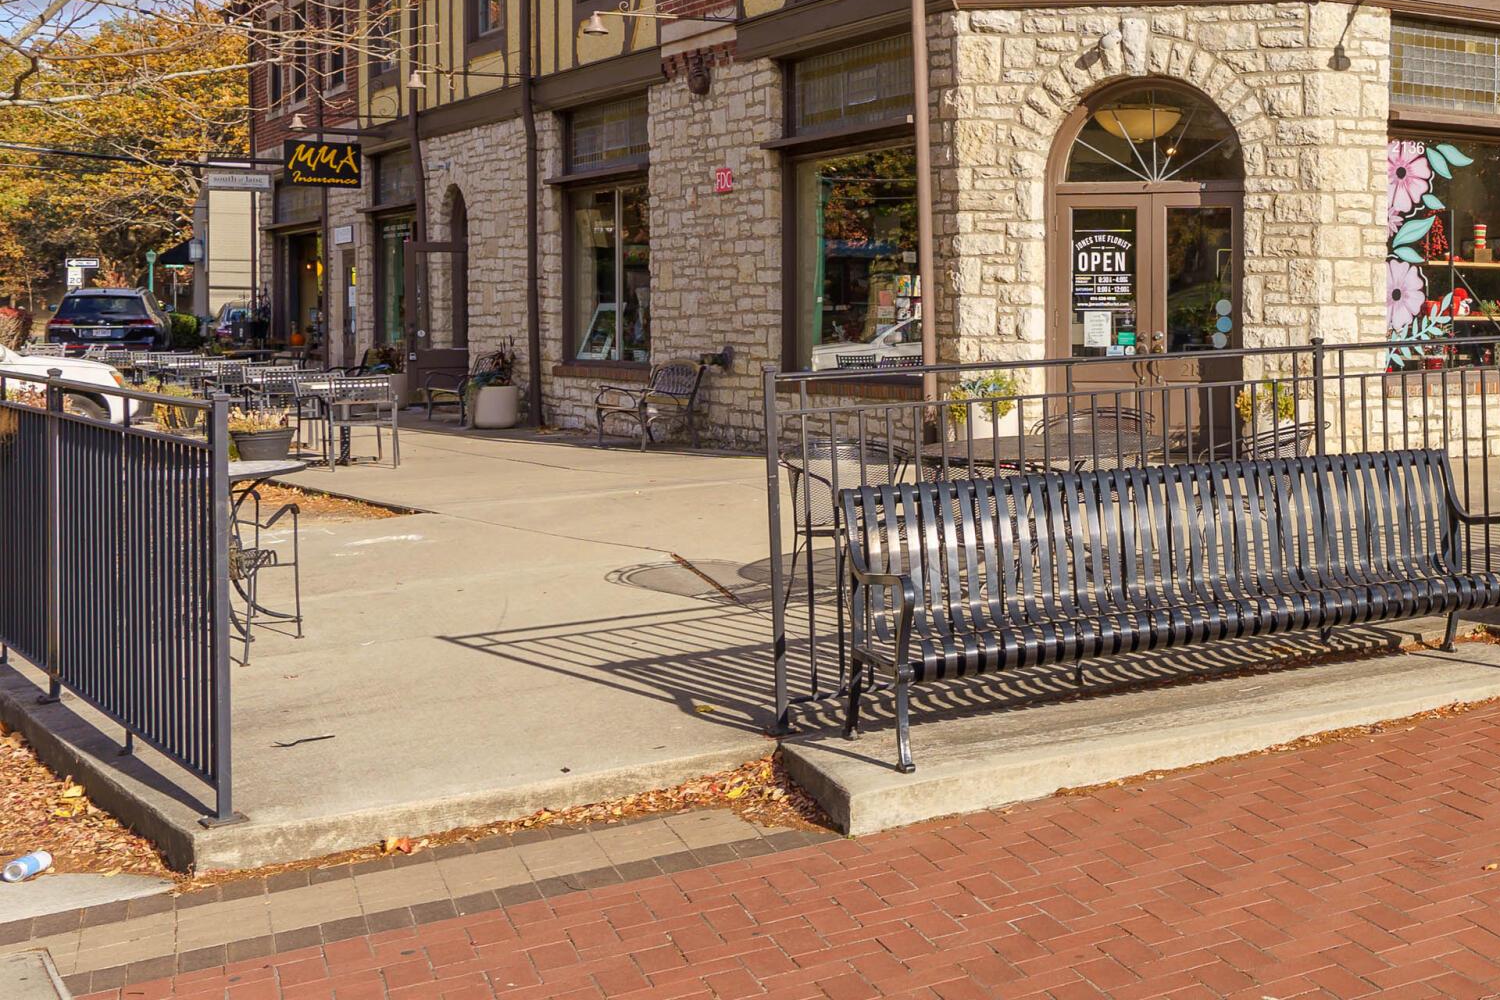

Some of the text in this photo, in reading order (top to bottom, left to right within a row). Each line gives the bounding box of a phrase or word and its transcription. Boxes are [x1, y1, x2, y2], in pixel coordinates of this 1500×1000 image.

[1391, 139, 1425, 155] 2136
[287, 143, 359, 173] MMA
[292, 170, 358, 185] Insurance
[1075, 234, 1132, 251] JONES THE FLORIST
[1078, 251, 1126, 272] OPEN
